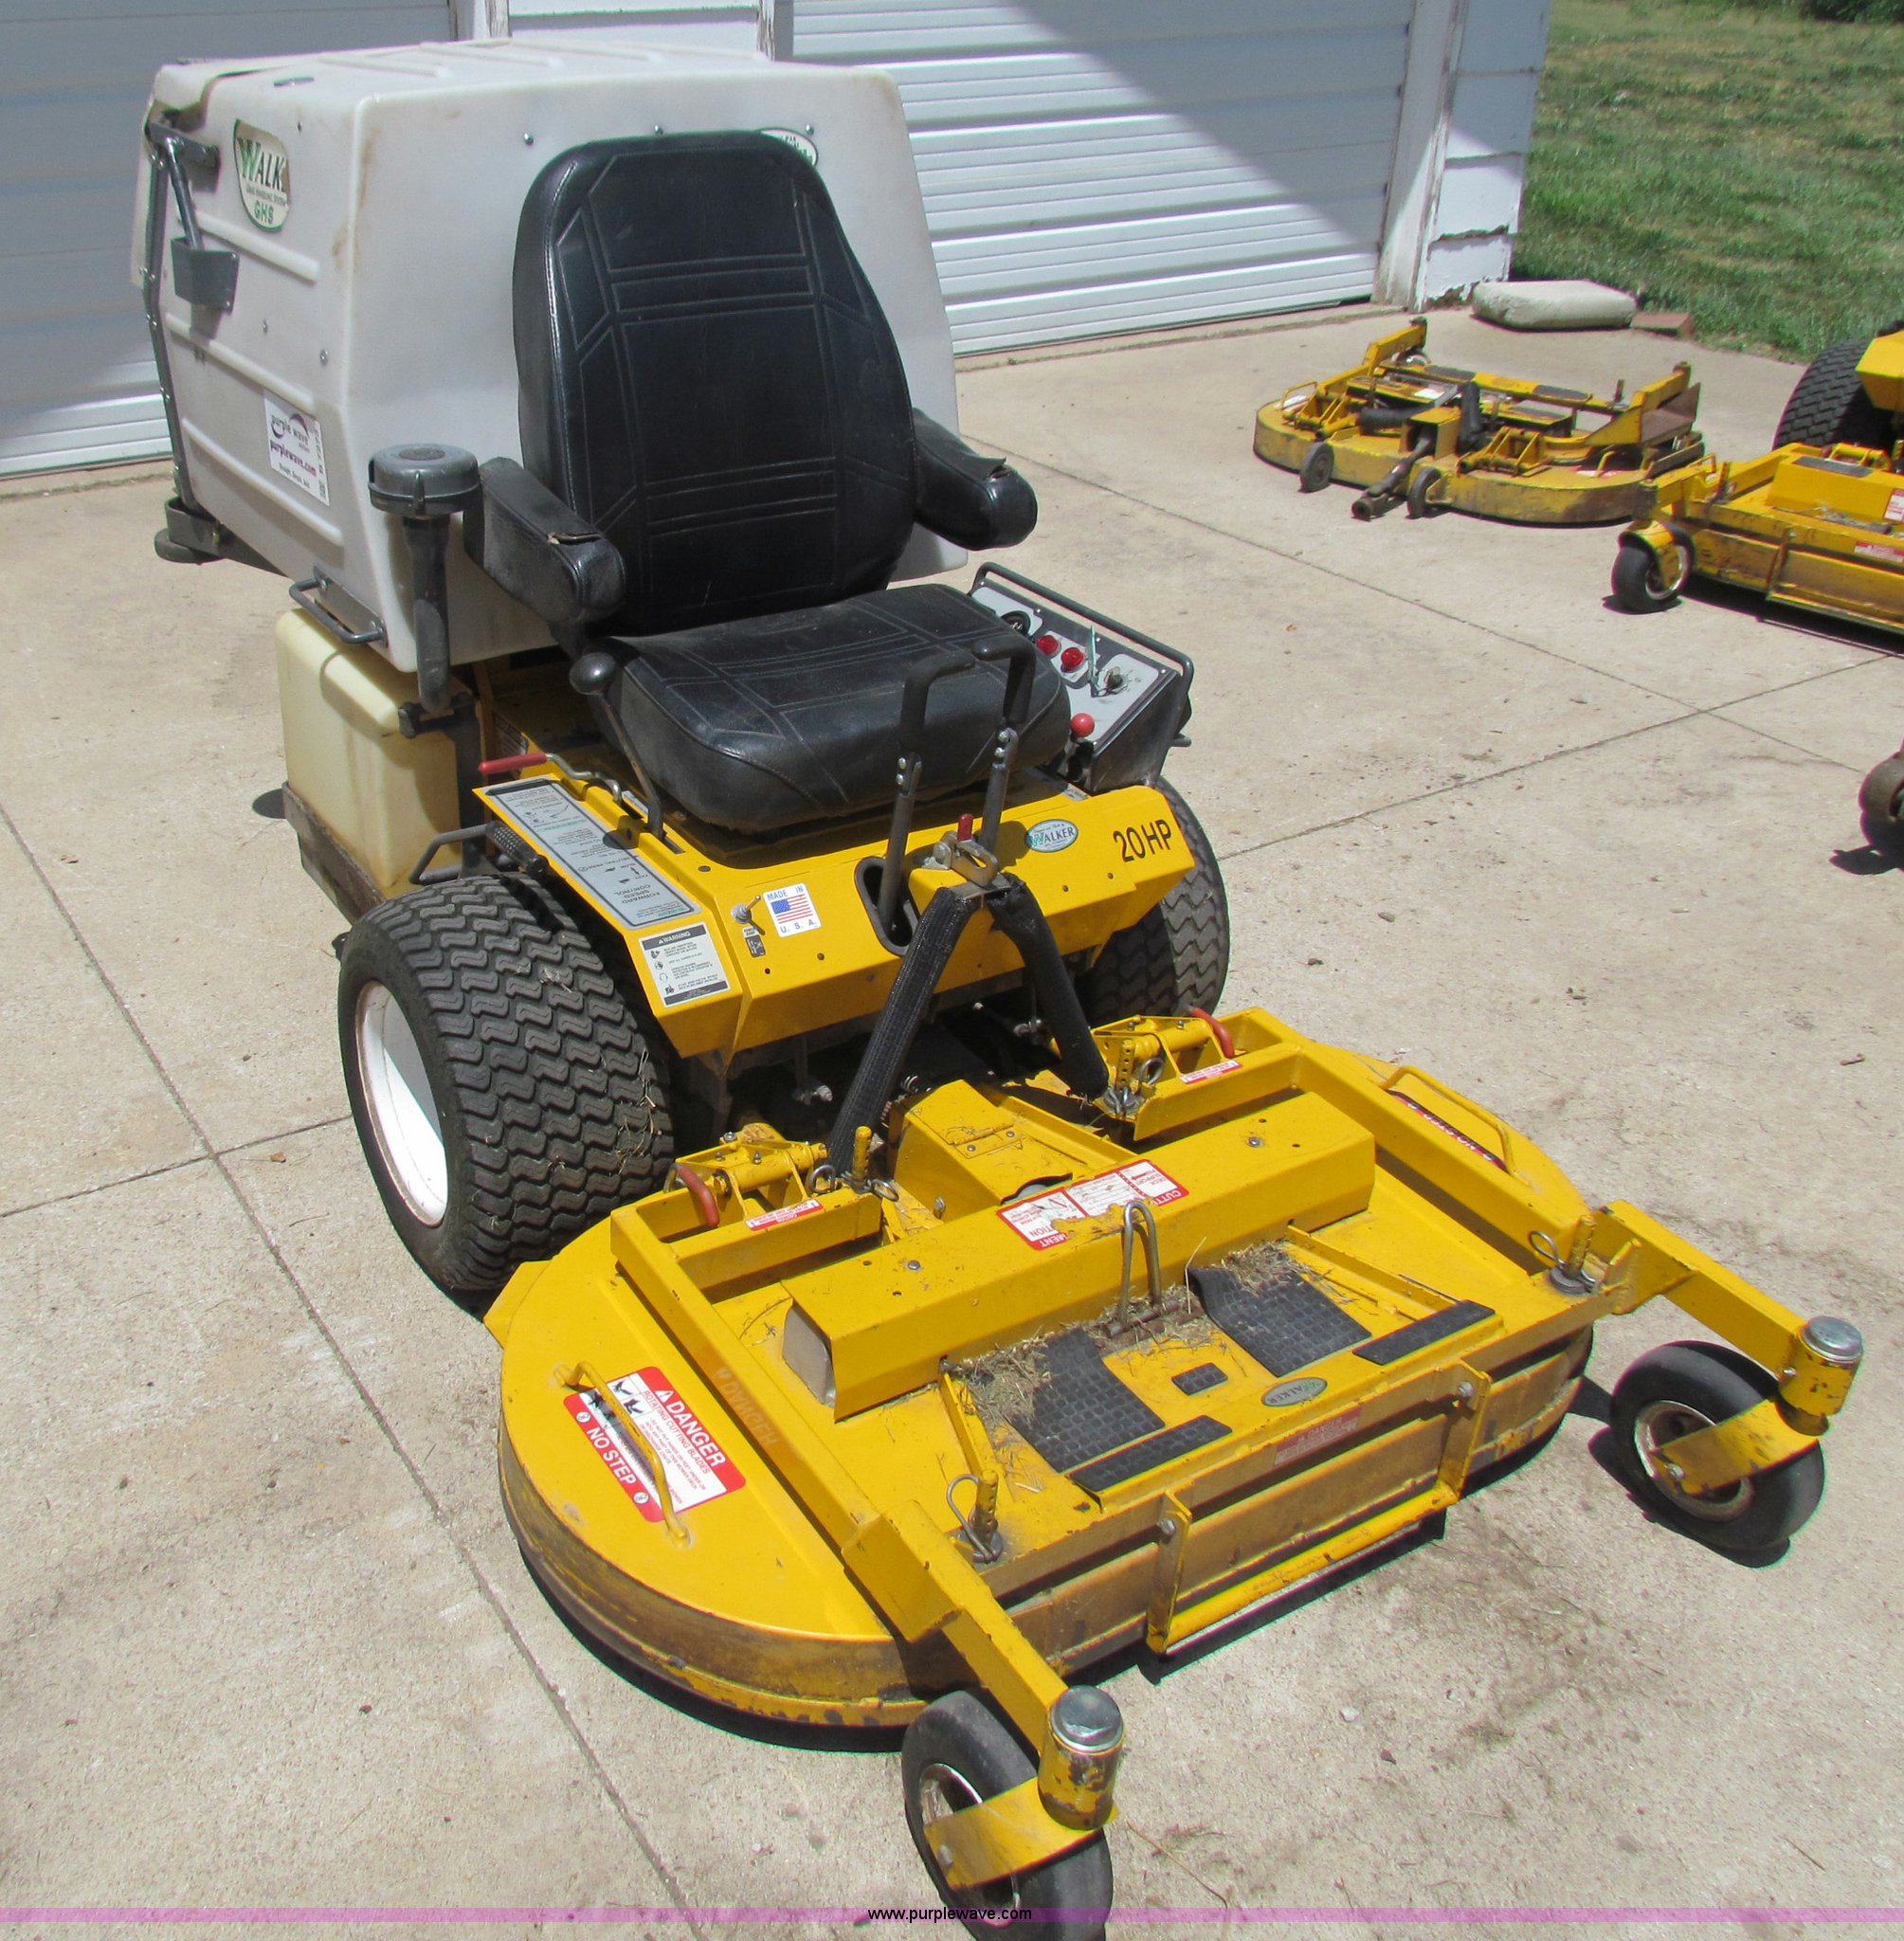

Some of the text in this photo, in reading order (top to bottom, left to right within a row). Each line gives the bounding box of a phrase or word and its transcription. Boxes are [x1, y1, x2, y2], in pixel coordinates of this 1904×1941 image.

[237, 137, 285, 190] WALK
[1030, 827, 1075, 847] WALKER
[613, 883, 651, 896] CONTROL
[621, 891, 660, 904] FORWARD
[623, 888, 649, 898] SPEED
[767, 885, 804, 900] MADE IN
[662, 930, 691, 943] WARNING
[1151, 1188, 1182, 1206] CUTTI
[1027, 1224, 1053, 1237] TION
[1038, 1232, 1065, 1248] MENT
[642, 1389, 710, 1475] ROTATING CUTTING BLADES
[664, 1400, 727, 1468] DANGER
[585, 1425, 611, 1452] NO
[601, 1448, 638, 1480] STEP
